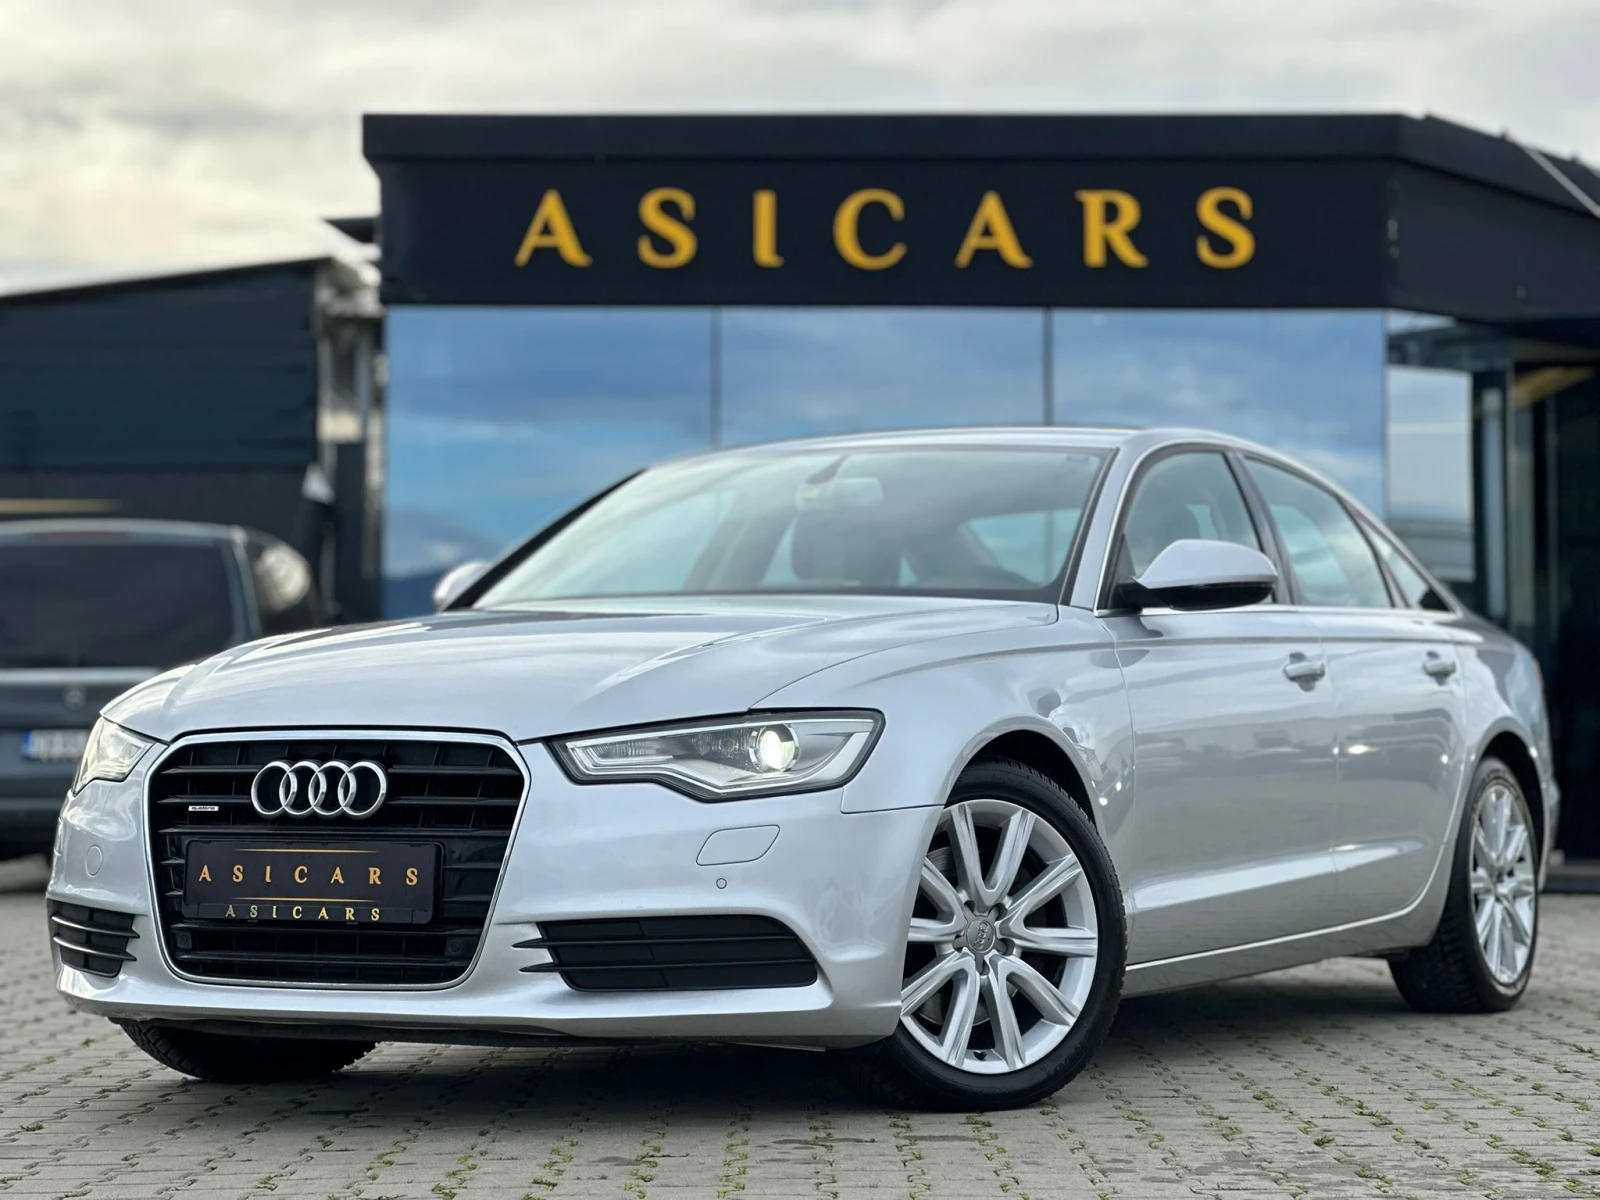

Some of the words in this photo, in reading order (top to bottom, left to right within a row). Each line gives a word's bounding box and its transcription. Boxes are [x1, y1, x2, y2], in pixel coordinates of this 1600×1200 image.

[514, 187, 1256, 270] ASICARS
[198, 864, 419, 886] ASICARS
[225, 904, 381, 922] ASICARS
